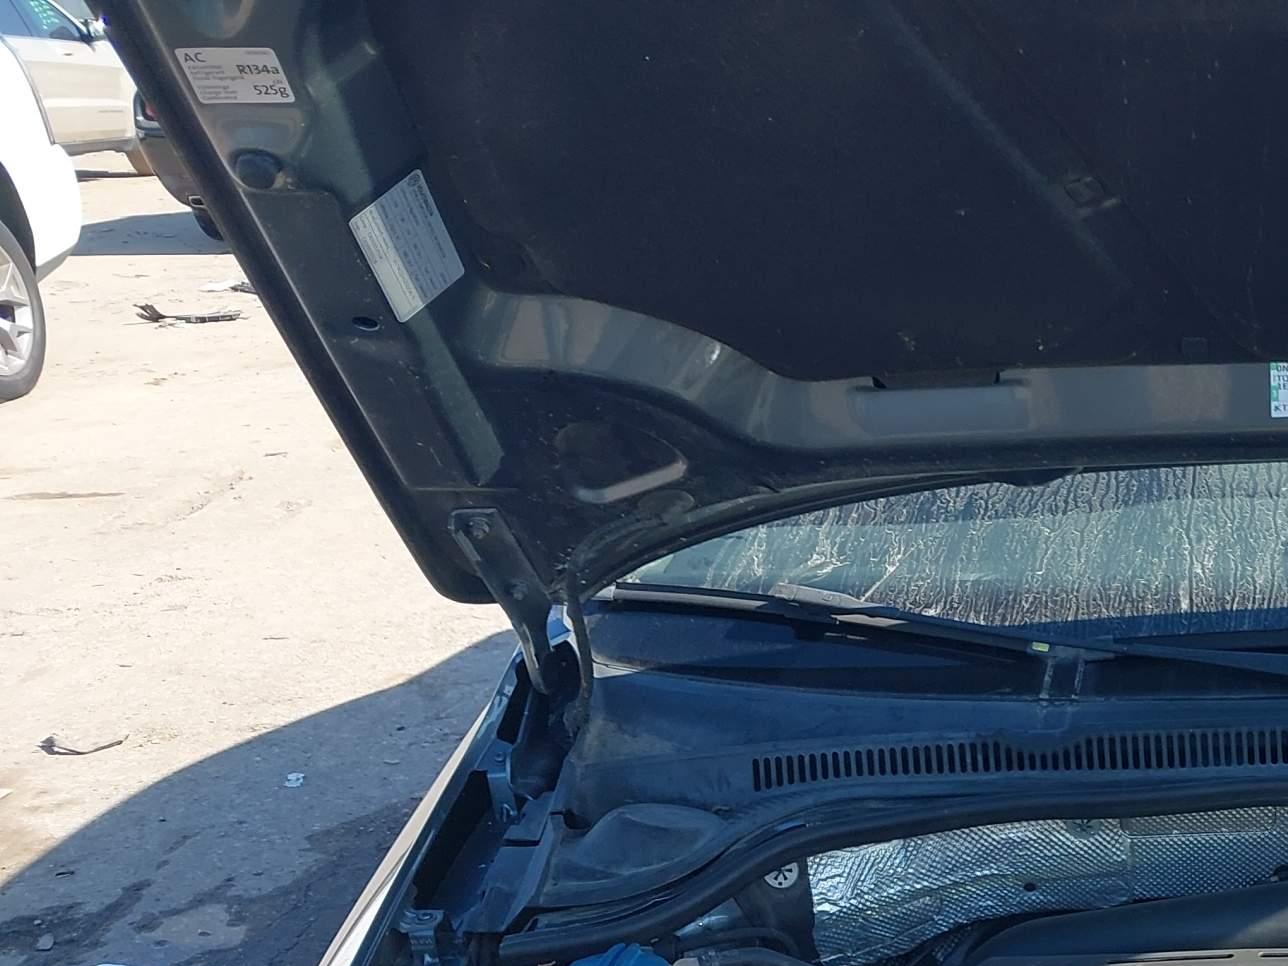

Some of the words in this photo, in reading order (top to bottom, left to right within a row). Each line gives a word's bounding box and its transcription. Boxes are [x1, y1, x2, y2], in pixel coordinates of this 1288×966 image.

[183, 52, 207, 63] AC
[236, 64, 280, 75] R134a
[253, 84, 290, 98] 525g
